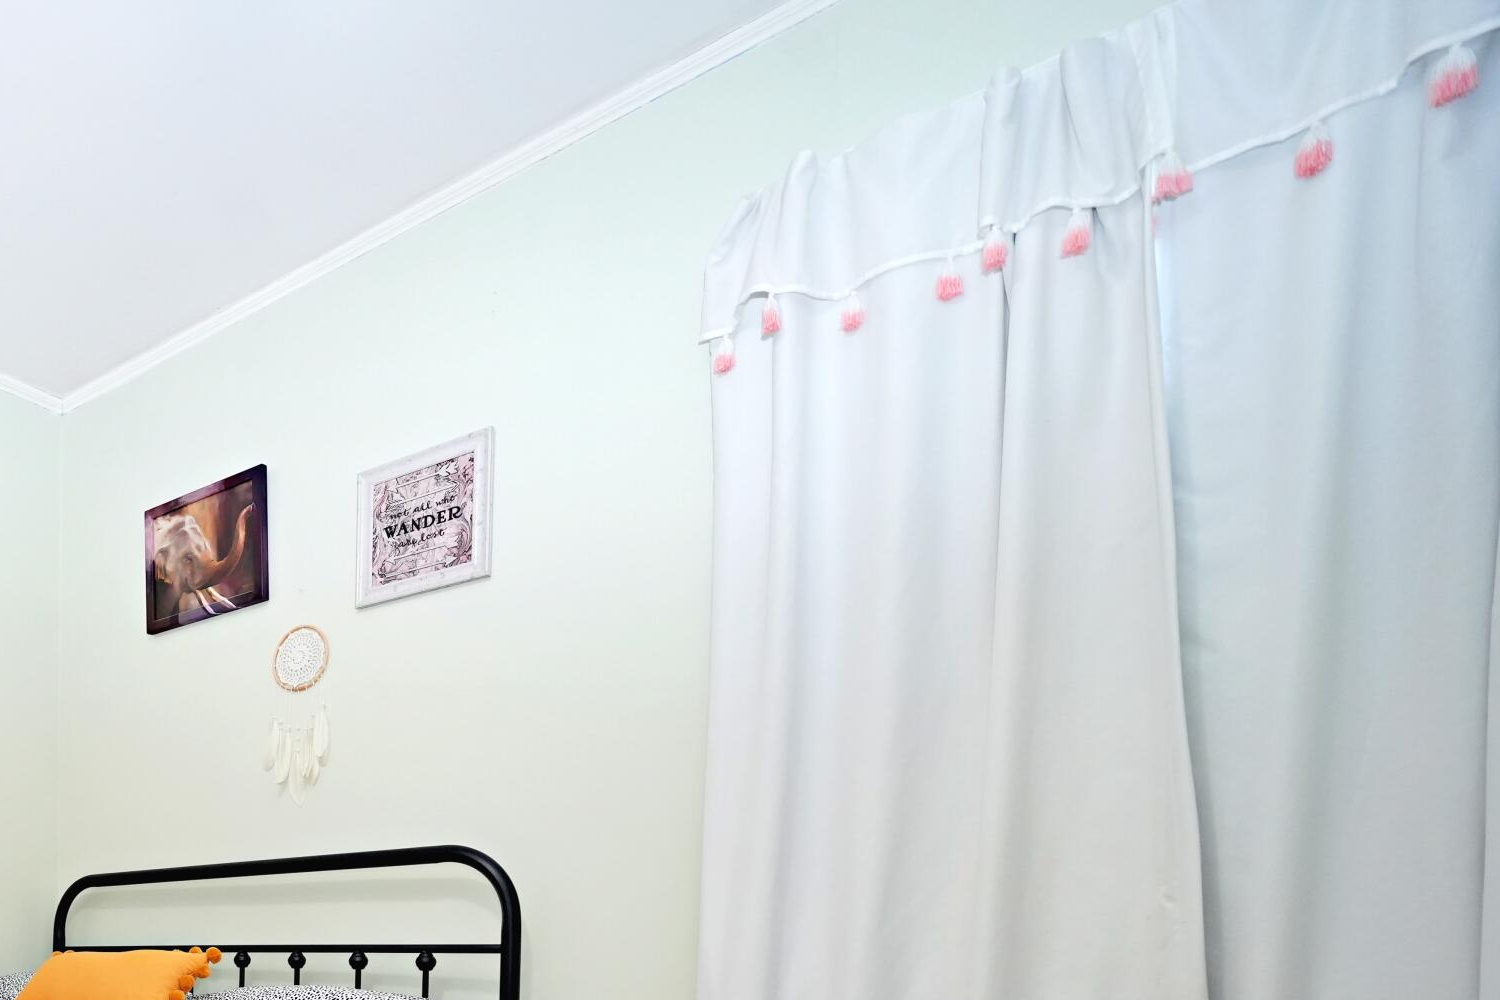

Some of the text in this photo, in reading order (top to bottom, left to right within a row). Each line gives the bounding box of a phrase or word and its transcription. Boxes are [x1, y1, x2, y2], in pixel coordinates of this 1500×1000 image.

[390, 493, 457, 520] not all who
[383, 504, 463, 539] WANDER
[398, 526, 447, 549] are lost
